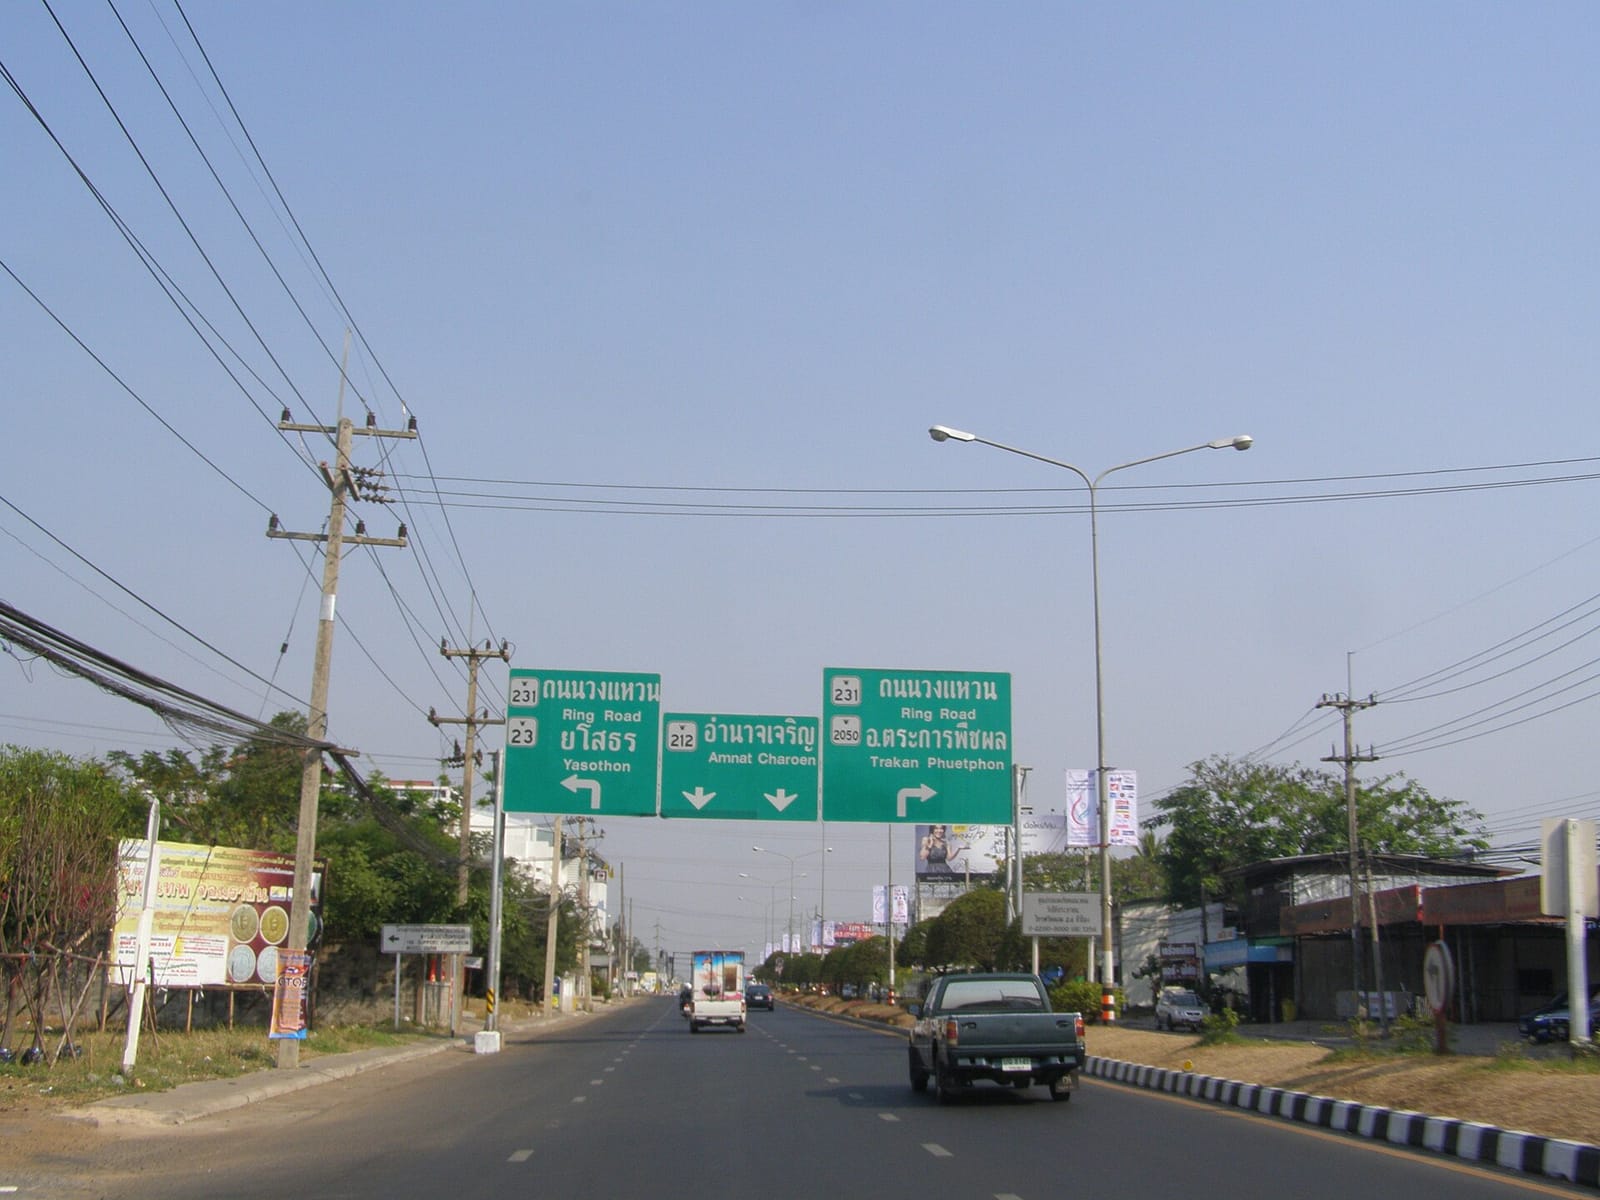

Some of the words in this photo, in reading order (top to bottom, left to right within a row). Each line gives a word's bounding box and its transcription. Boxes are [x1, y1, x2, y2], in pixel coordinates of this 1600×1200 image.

[512, 689, 537, 703] 231
[543, 679, 660, 702] ถนนวงแหวน
[835, 688, 858, 702] 231
[879, 678, 998, 701] ถนนวงแหวน
[562, 708, 595, 723] Ring
[604, 710, 641, 722] Road
[901, 707, 933, 722] Ring
[939, 708, 977, 720] Road
[511, 729, 533, 744] 23
[560, 723, 637, 752] ยโสธร
[670, 734, 694, 747] 212
[704, 716, 815, 752] อำนาจเจริญ
[833, 729, 859, 741] 2050
[866, 722, 1007, 750] อ.ตระการพืชผล
[563, 758, 631, 772] Yasothon
[708, 752, 752, 764] Amnat
[757, 752, 817, 766] Charoen
[869, 756, 919, 769] Trakan
[927, 757, 1005, 772] Phuetphon
